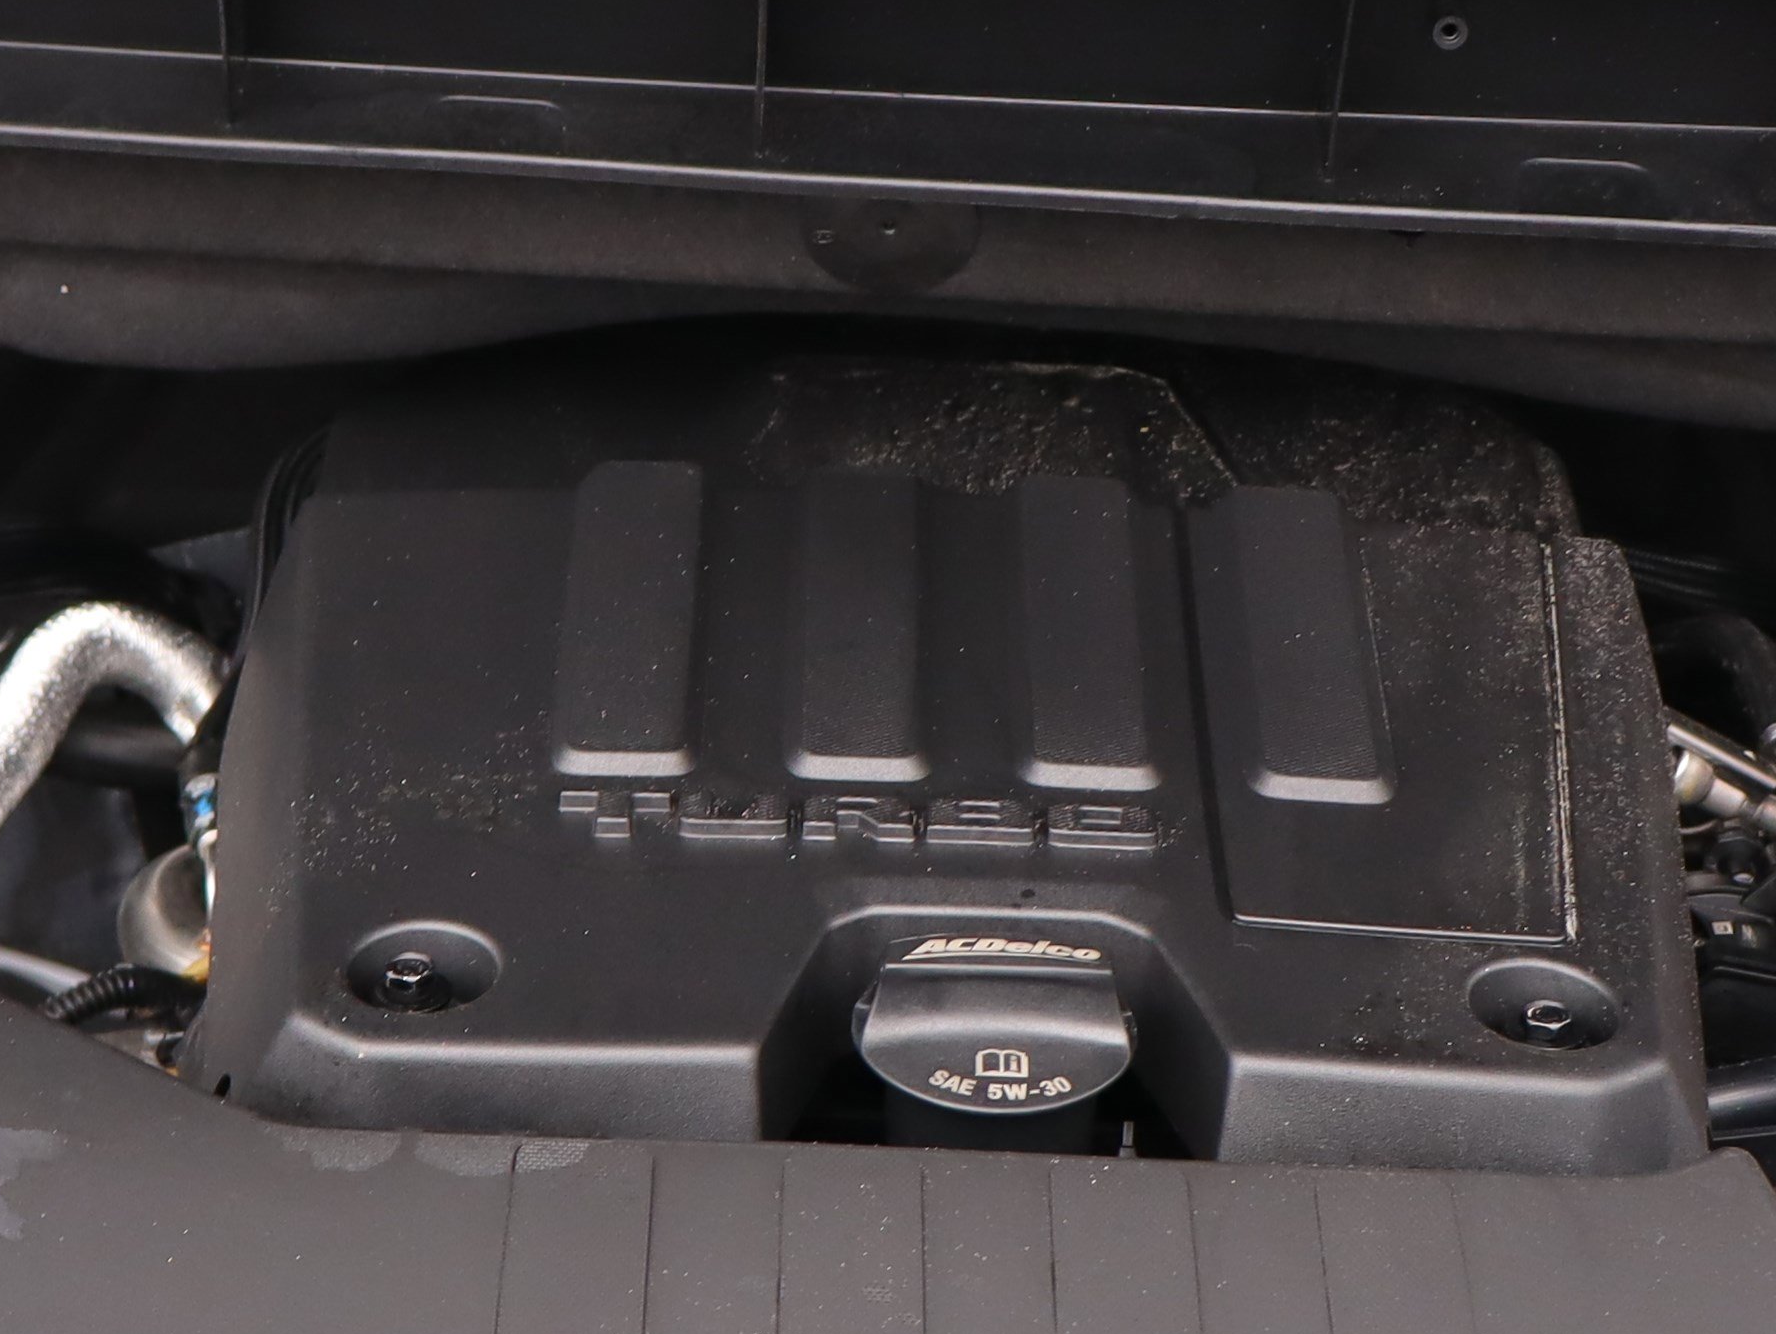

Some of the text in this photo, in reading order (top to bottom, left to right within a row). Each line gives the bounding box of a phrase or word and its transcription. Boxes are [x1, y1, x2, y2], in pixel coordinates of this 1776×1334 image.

[558, 789, 1158, 851] TURBO
[908, 937, 1102, 962] ACDelco
[928, 1069, 1073, 1102] SAE 5W-30
